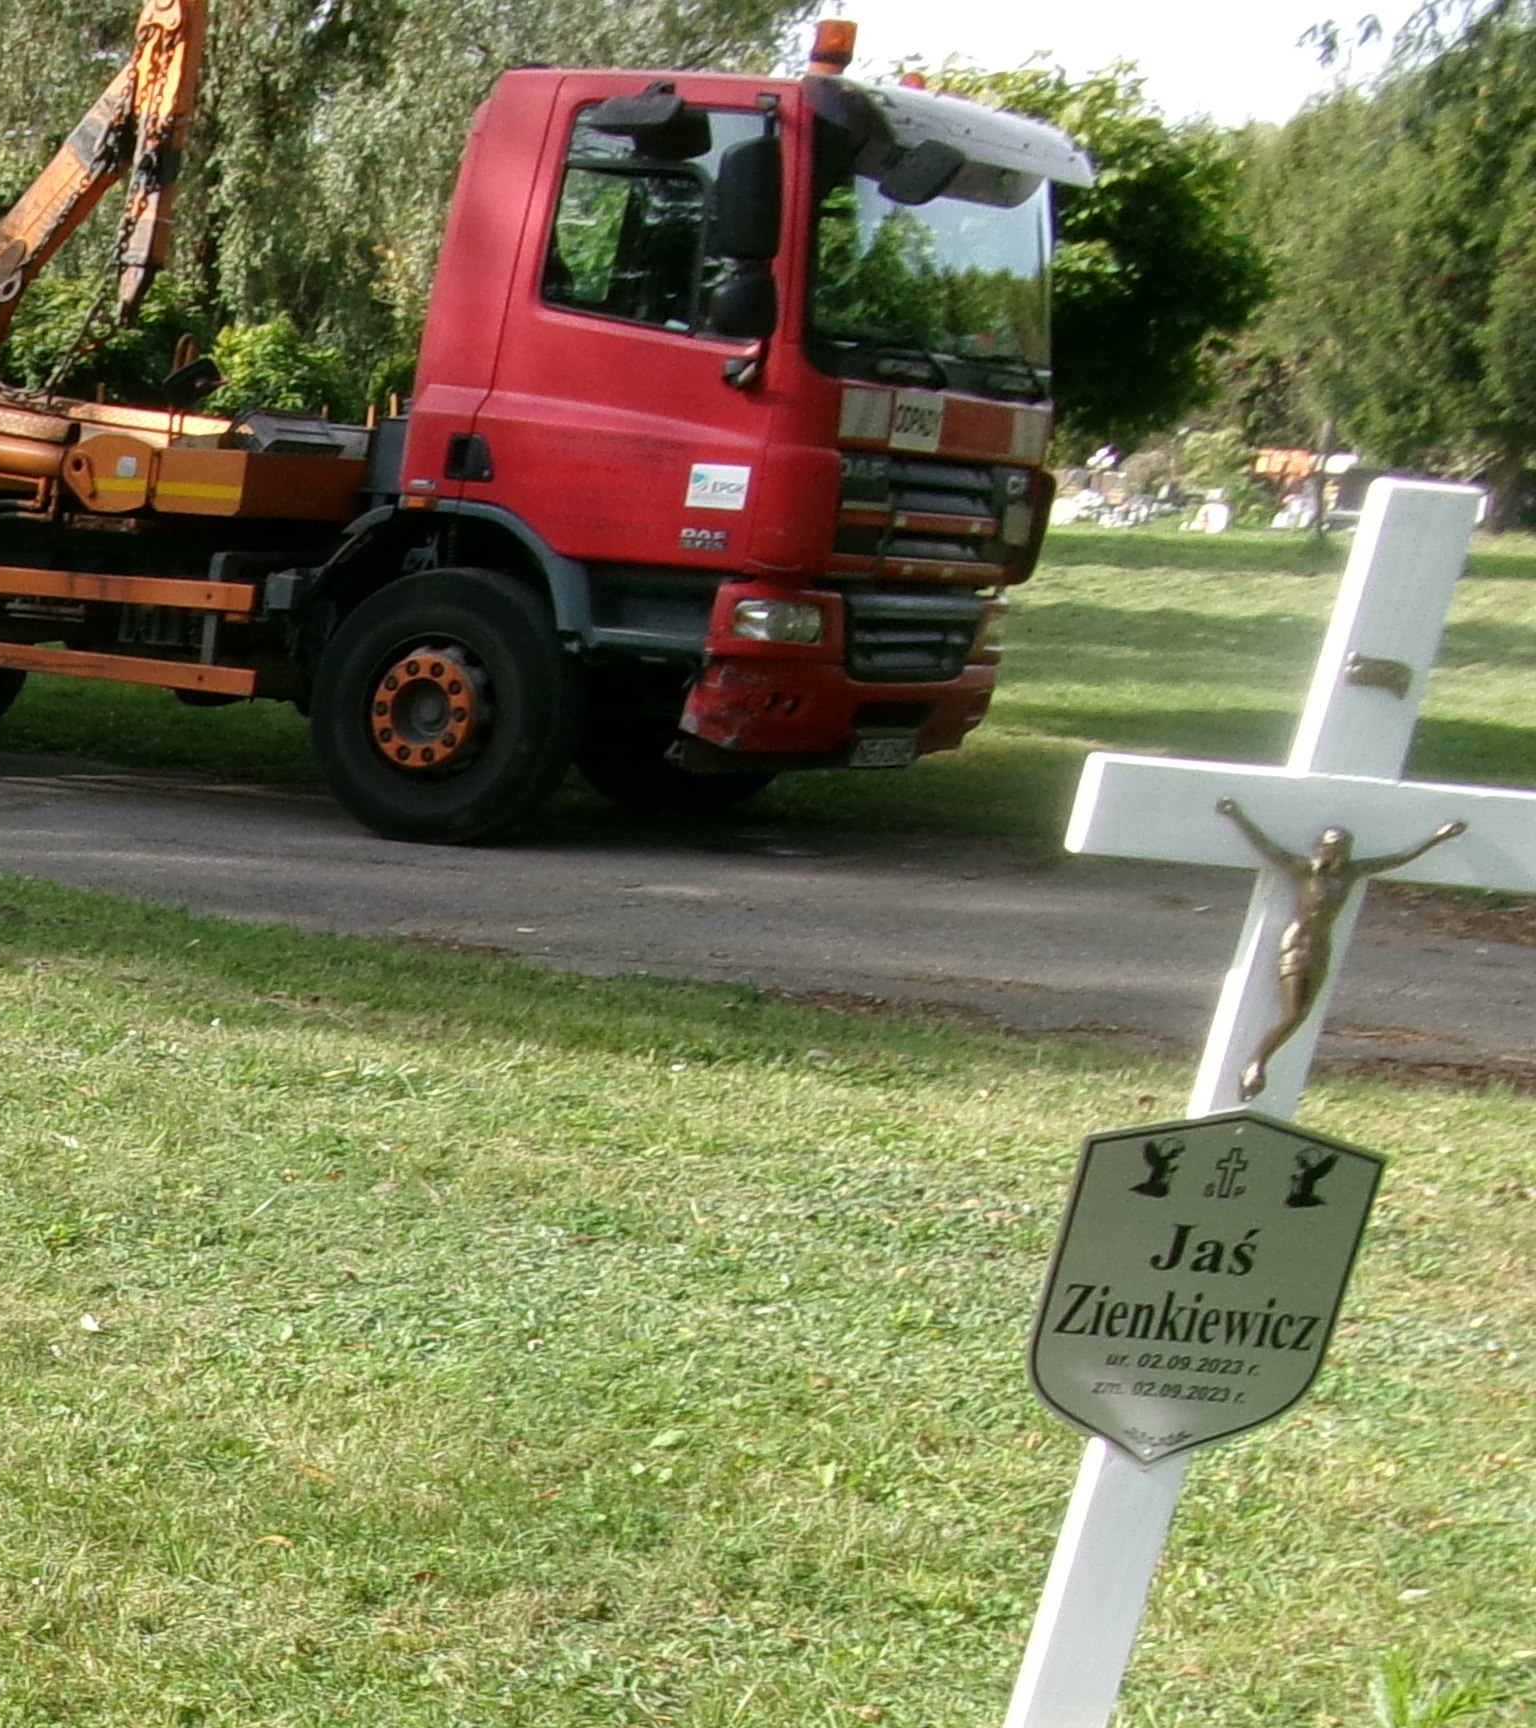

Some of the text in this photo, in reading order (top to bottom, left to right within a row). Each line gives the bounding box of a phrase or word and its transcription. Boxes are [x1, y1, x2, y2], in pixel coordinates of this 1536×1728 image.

[1149, 1224, 1260, 1276] Jaś
[1054, 1284, 1321, 1351] Zienkiewicz
[1106, 1353, 1130, 1367] ur.
[1137, 1353, 1244, 1375] 02.09.2023
[1130, 1382, 1231, 1403] 02.09.2023
